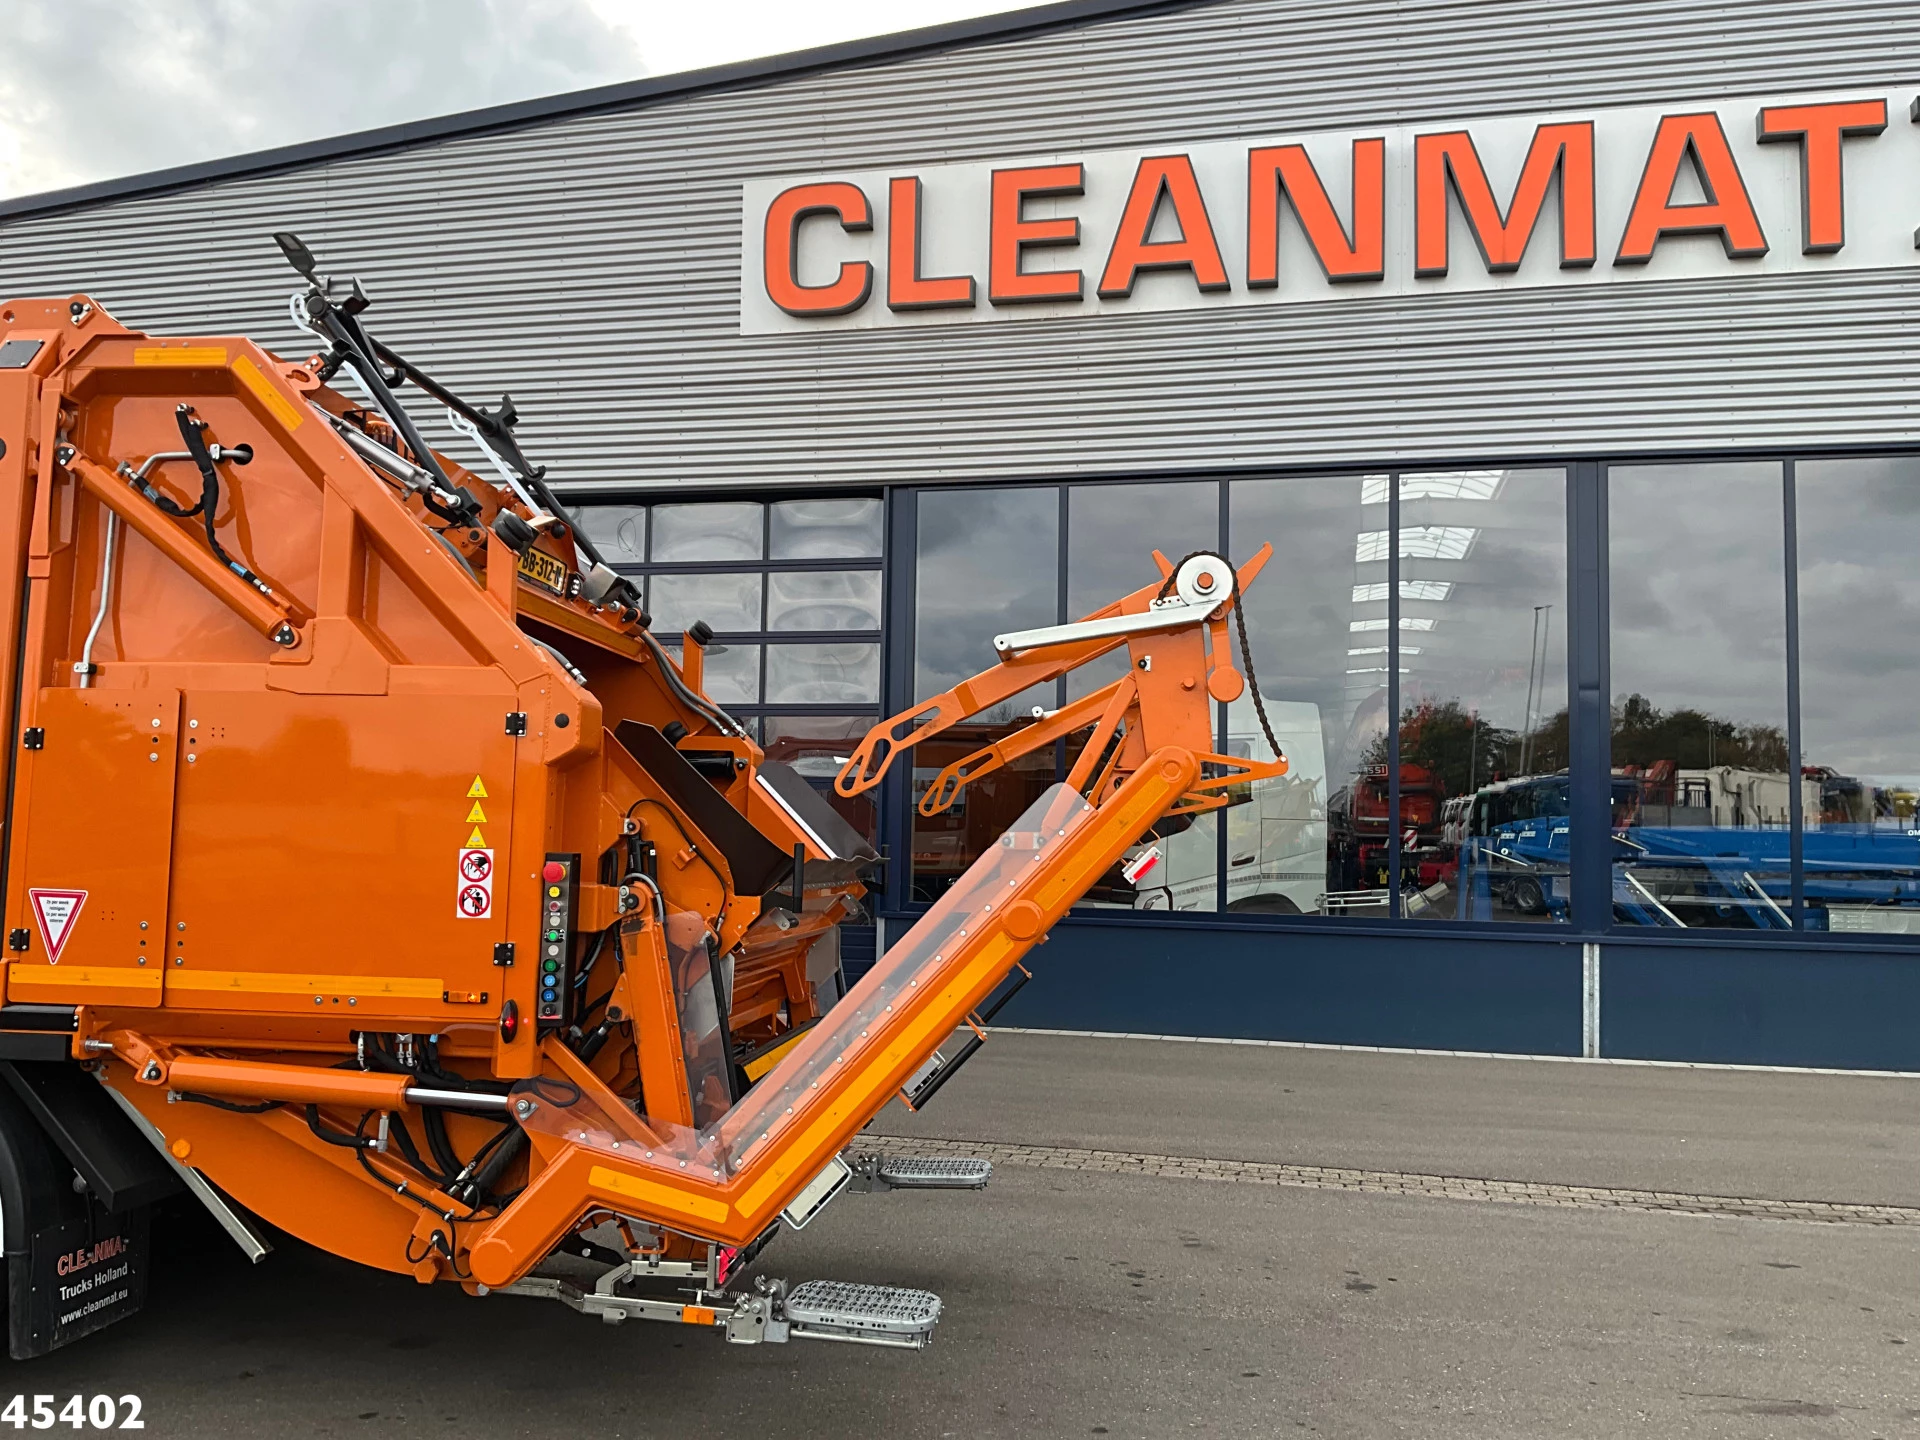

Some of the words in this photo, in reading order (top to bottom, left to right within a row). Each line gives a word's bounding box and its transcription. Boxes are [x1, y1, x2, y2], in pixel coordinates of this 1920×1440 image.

[764, 99, 1888, 317] CLEANMAT
[60, 1279, 93, 1301] Trucks
[94, 1262, 128, 1287] Holland
[60, 1288, 128, 1325] www.cleanmat.eu
